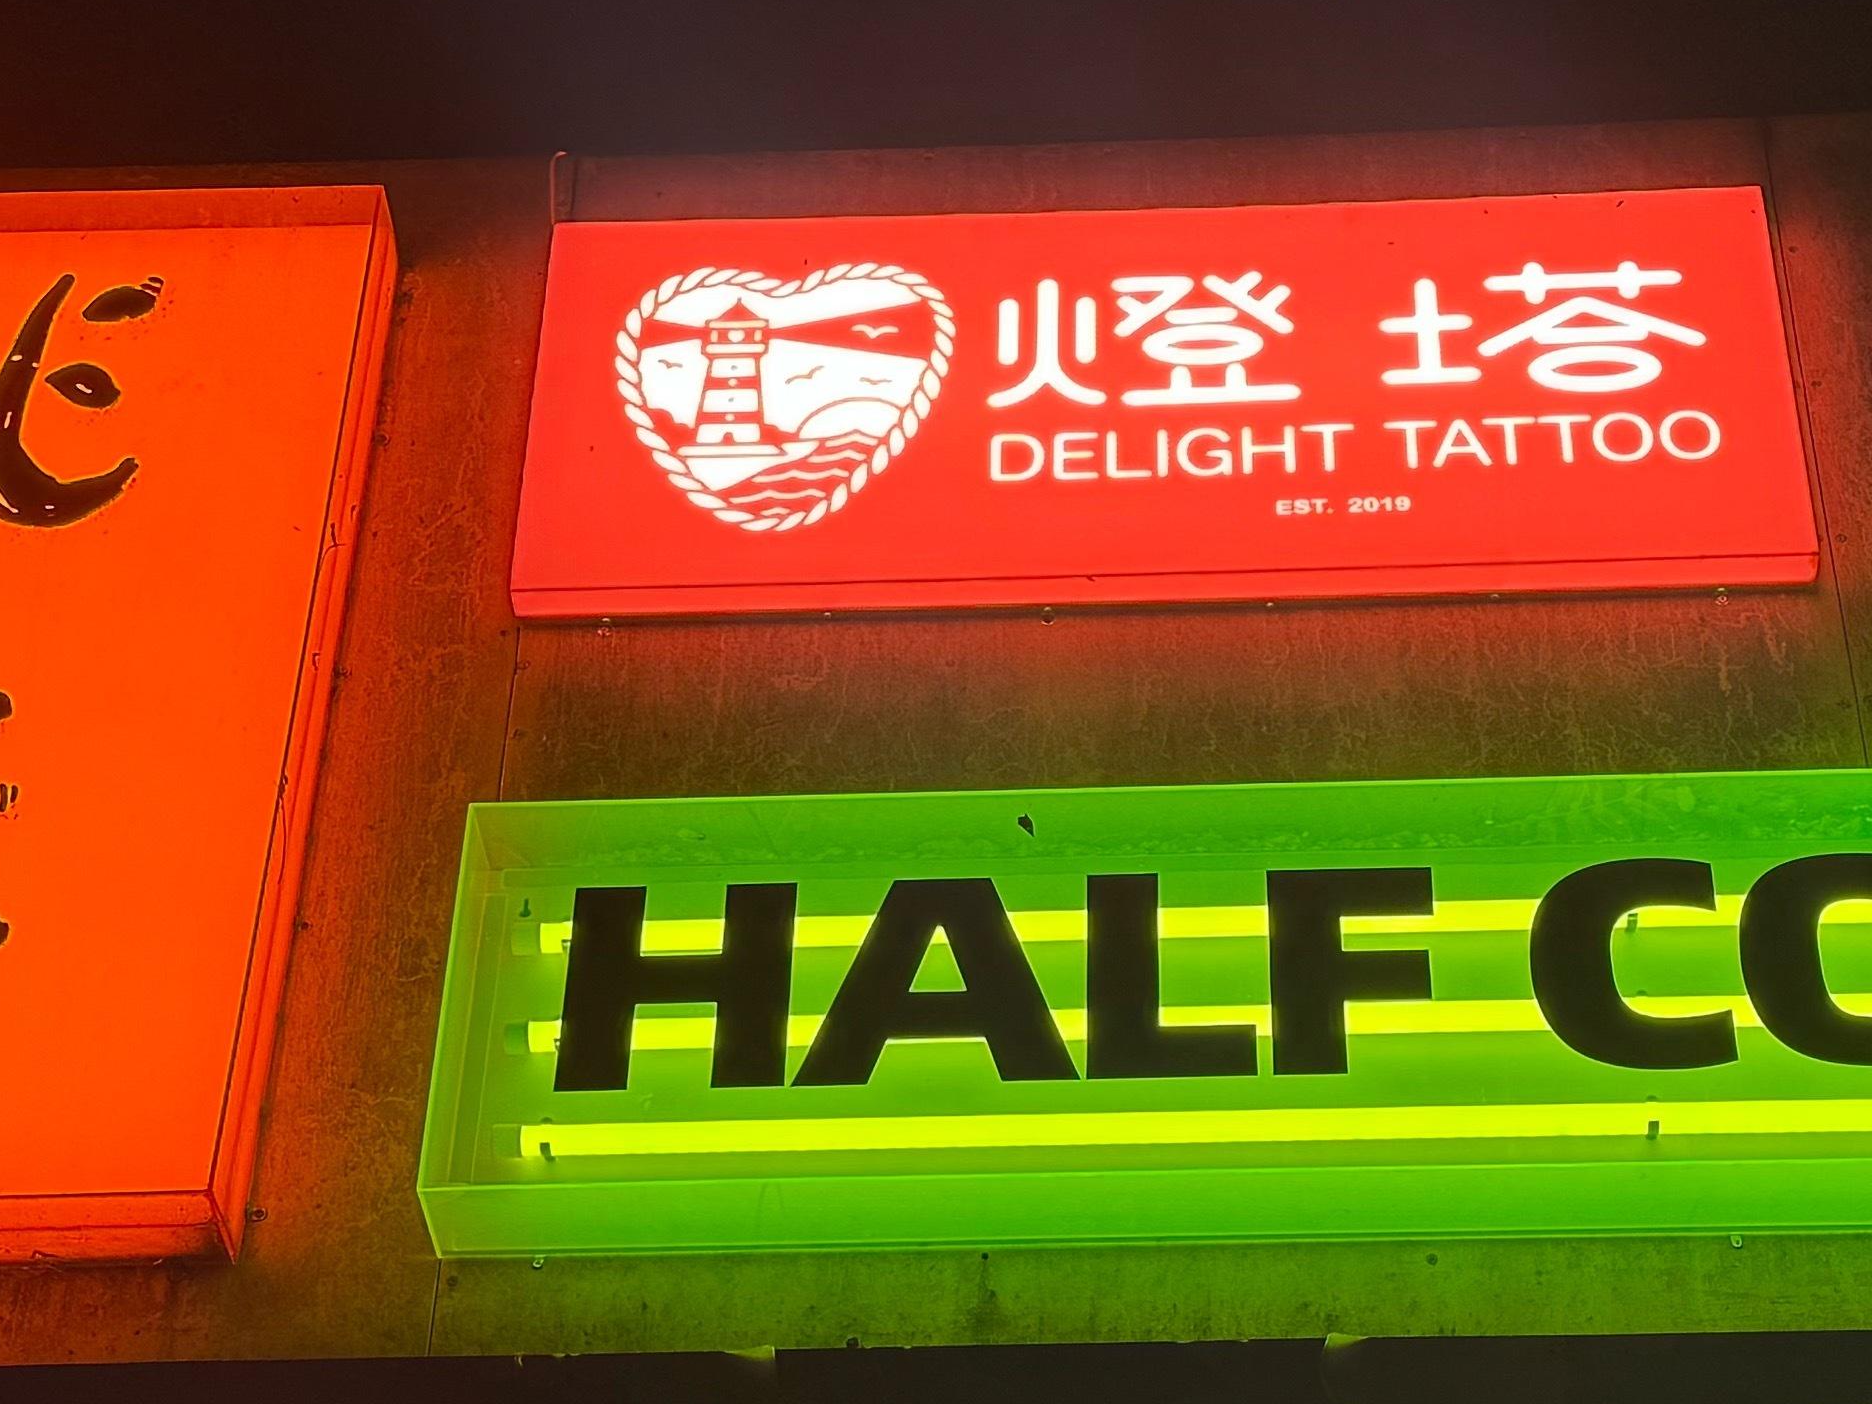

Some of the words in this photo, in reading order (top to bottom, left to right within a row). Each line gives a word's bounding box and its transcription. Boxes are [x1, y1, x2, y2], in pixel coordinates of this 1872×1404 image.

[988, 422, 1356, 483] DELIGHT
[1382, 408, 1722, 470] TATTOO
[1274, 498, 1335, 516] EST.
[1347, 495, 1412, 514] 2019
[554, 866, 1433, 1091] HALF
